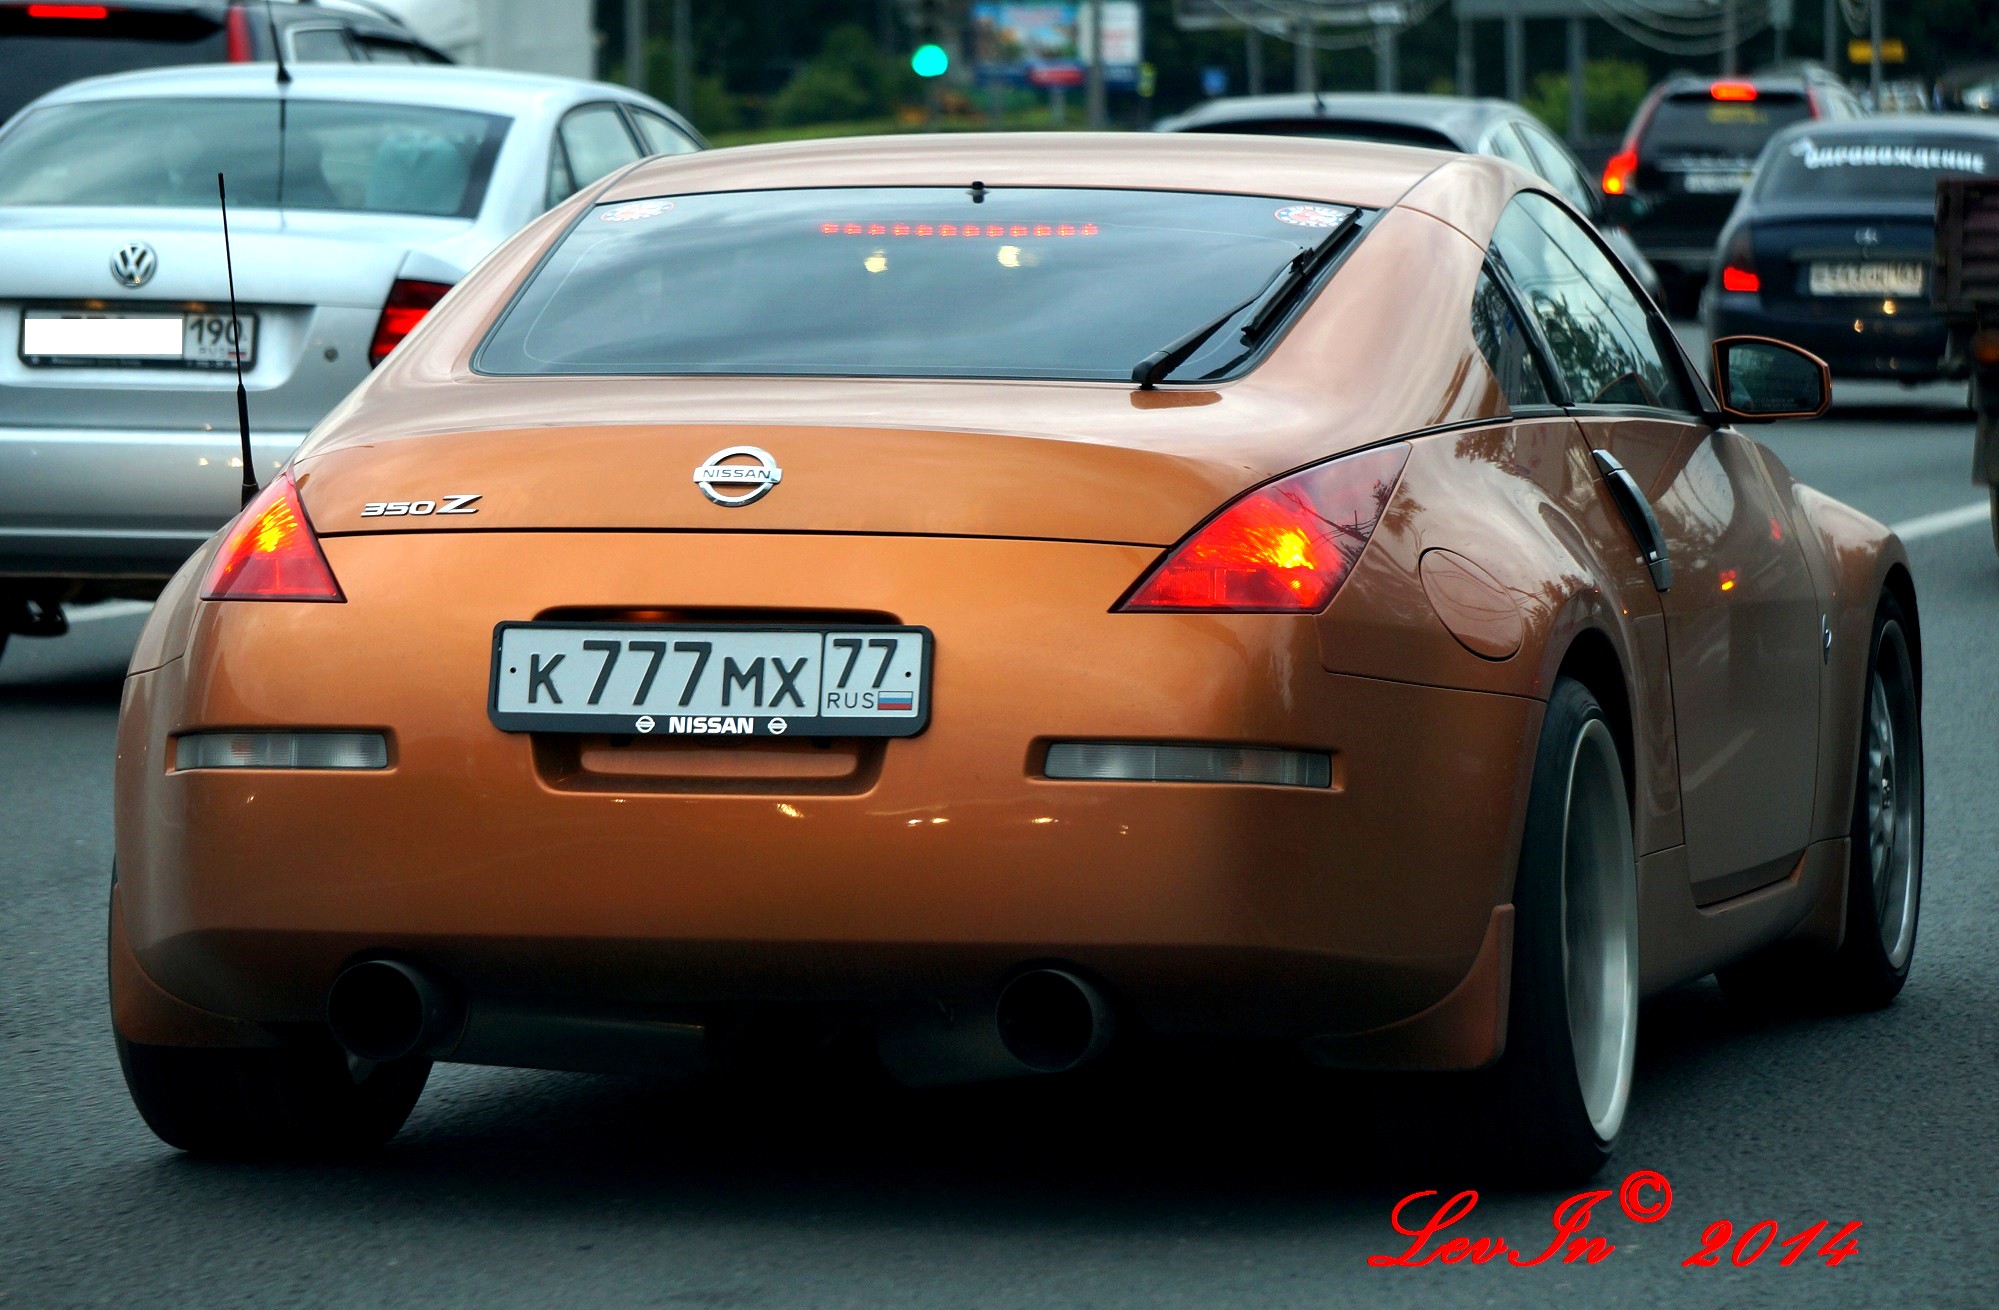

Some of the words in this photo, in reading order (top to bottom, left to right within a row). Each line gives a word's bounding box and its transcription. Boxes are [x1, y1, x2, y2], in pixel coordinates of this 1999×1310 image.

[190, 318, 244, 345] 190
[703, 469, 771, 479] NISSAN
[360, 494, 483, 517] 350Z
[833, 638, 898, 689] 77
[826, 692, 875, 710] RUS
[669, 716, 754, 734] NISSAN
